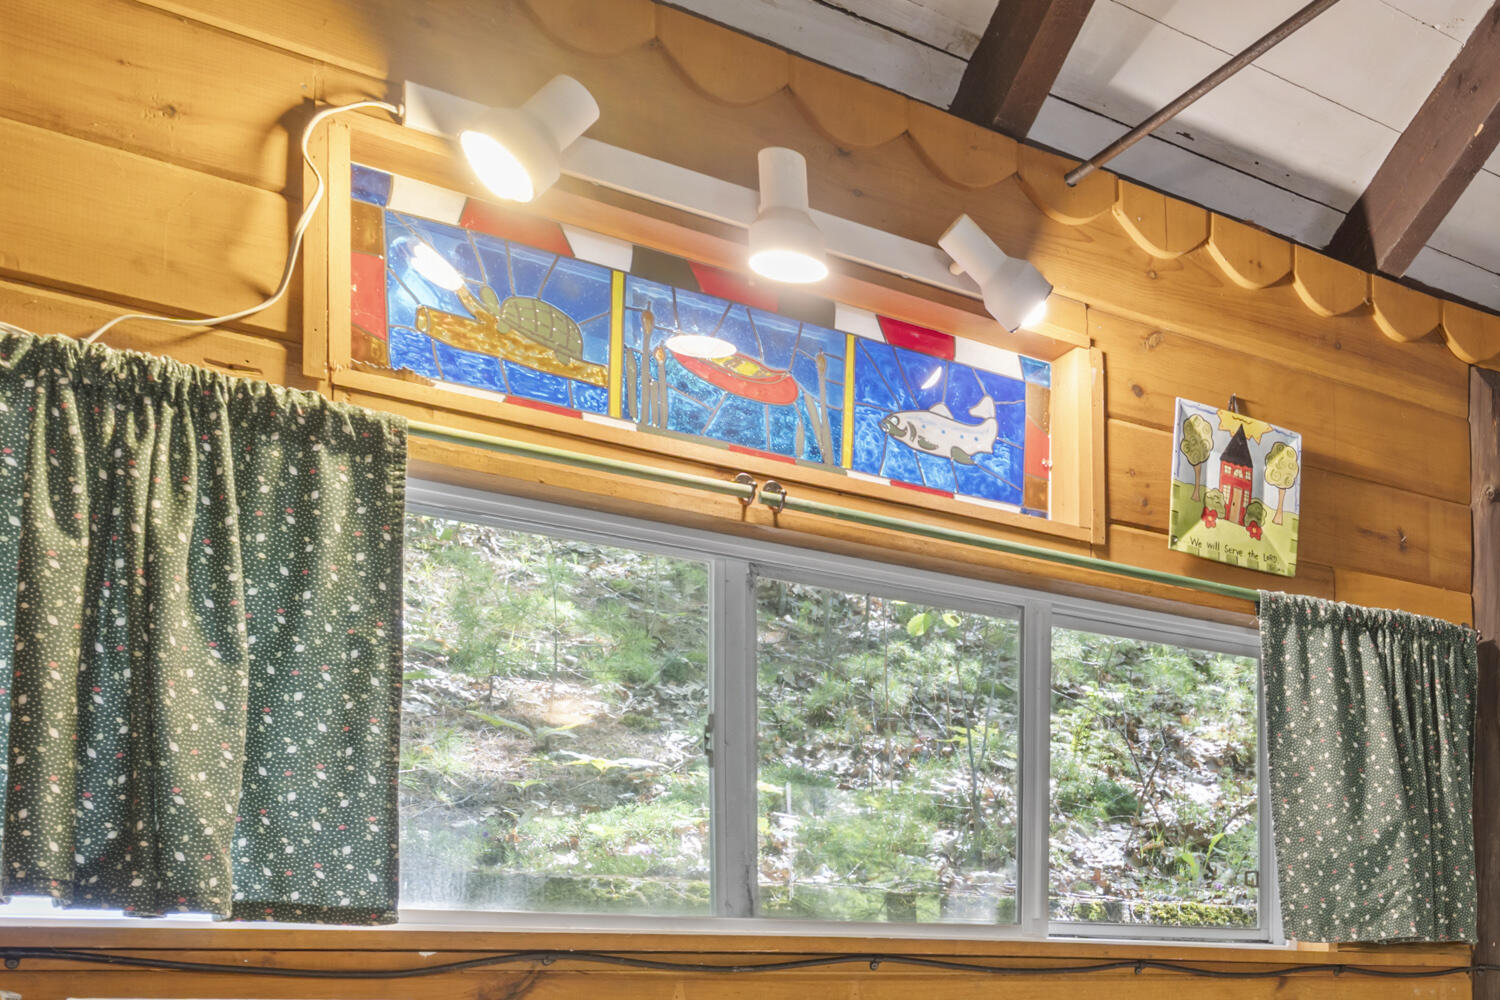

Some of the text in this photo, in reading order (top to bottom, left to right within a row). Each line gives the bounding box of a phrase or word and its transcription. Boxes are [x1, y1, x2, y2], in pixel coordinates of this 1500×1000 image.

[1190, 536, 1202, 547] We
[1207, 541, 1220, 551] will
[1248, 549, 1259, 559] the
